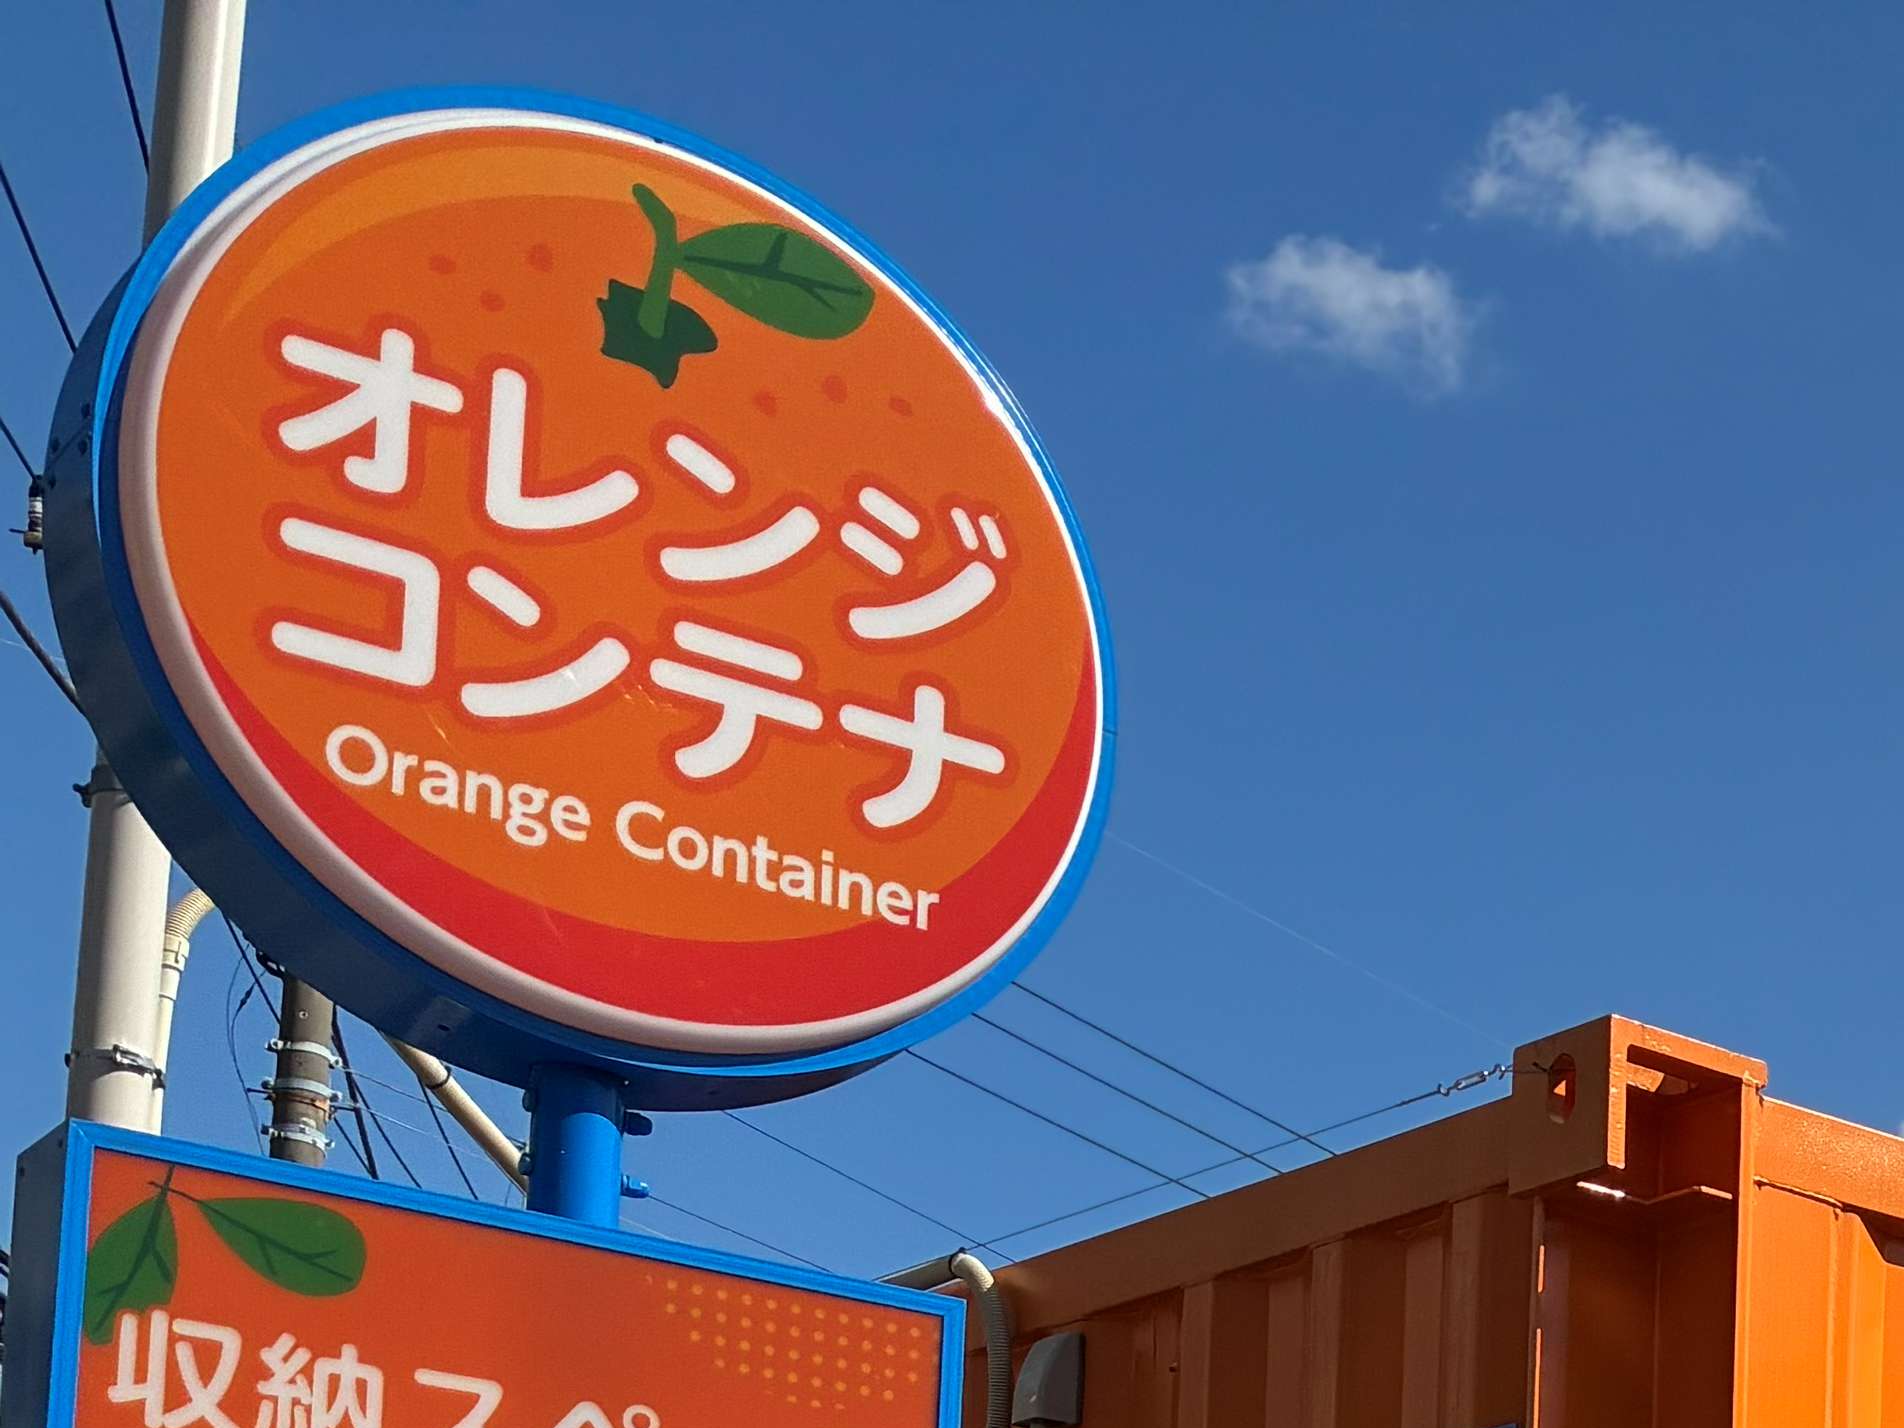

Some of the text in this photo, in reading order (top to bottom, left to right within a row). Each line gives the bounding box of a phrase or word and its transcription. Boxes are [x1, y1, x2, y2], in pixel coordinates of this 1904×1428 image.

[278, 328, 1008, 640] オレンジ
[271, 516, 1006, 829] コンテナ
[324, 722, 941, 933] Orange Container
